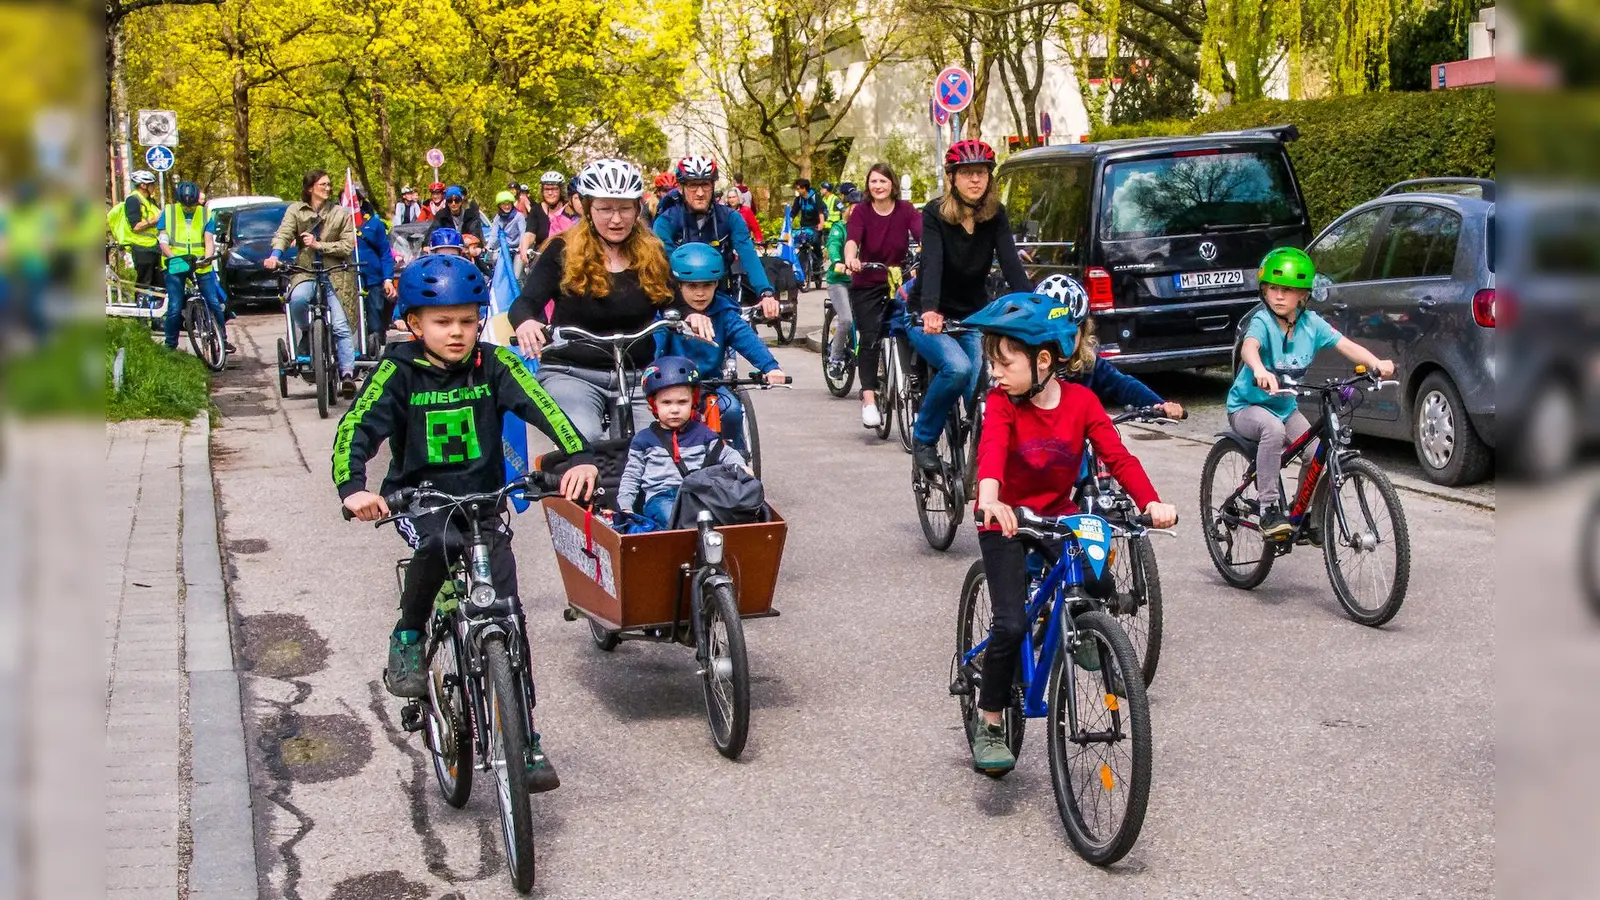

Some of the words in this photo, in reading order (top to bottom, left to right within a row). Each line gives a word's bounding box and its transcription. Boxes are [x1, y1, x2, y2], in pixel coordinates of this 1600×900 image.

[1181, 275, 1190, 286] M
[1197, 273, 1212, 286] DR
[1214, 271, 1241, 285] 2729
